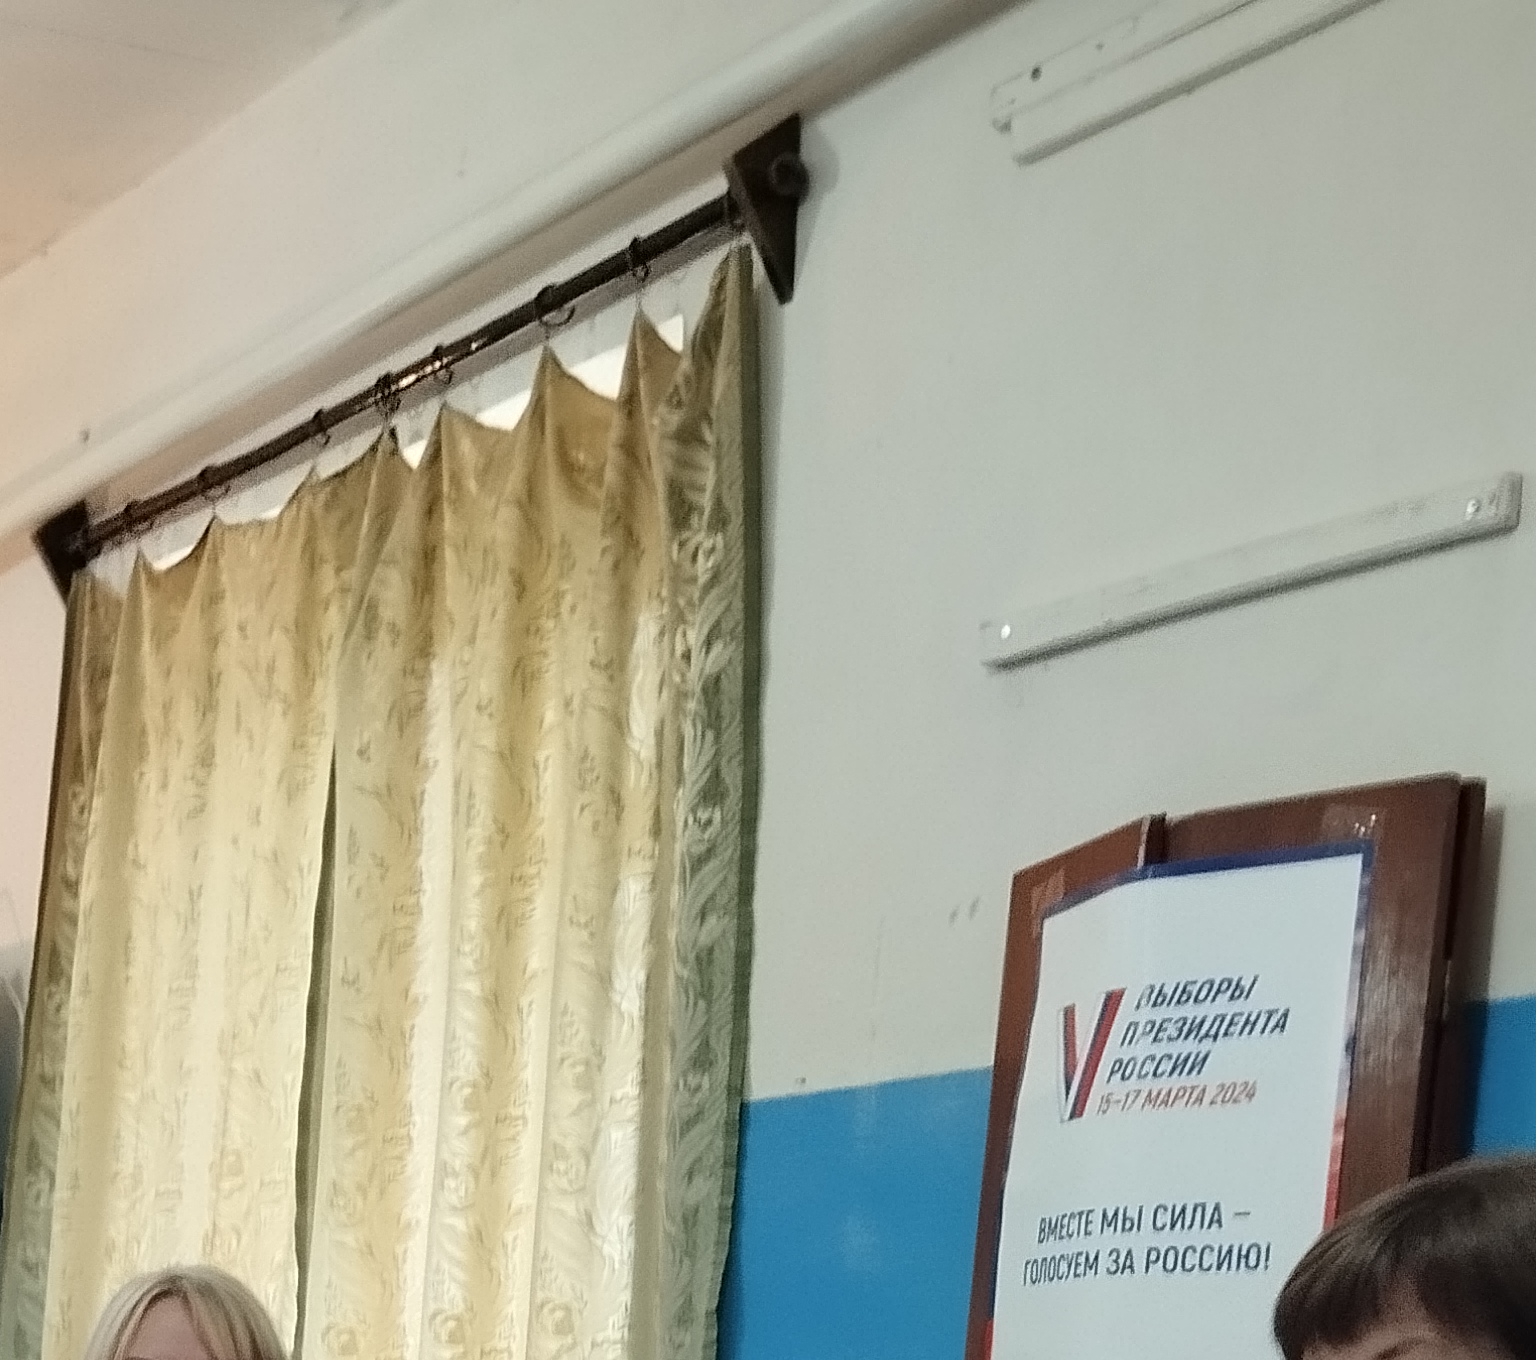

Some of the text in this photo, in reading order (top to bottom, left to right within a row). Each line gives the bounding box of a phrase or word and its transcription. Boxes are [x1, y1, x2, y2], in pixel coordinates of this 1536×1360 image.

[1120, 1006, 1291, 1048] ПРЕЗИДЕНТА
[1106, 1049, 1212, 1085] РОССИИ
[1141, 1084, 1208, 1111] МАРТА
[1209, 1079, 1258, 1106] 2024
[1037, 1208, 1096, 1244] ВМЕСТЕ
[1100, 1205, 1144, 1235] МЫ
[1152, 1201, 1224, 1232] СИЛА
[1023, 1241, 1272, 1287] ГОЛОСУЕМ ЗА РОССИЮ!
